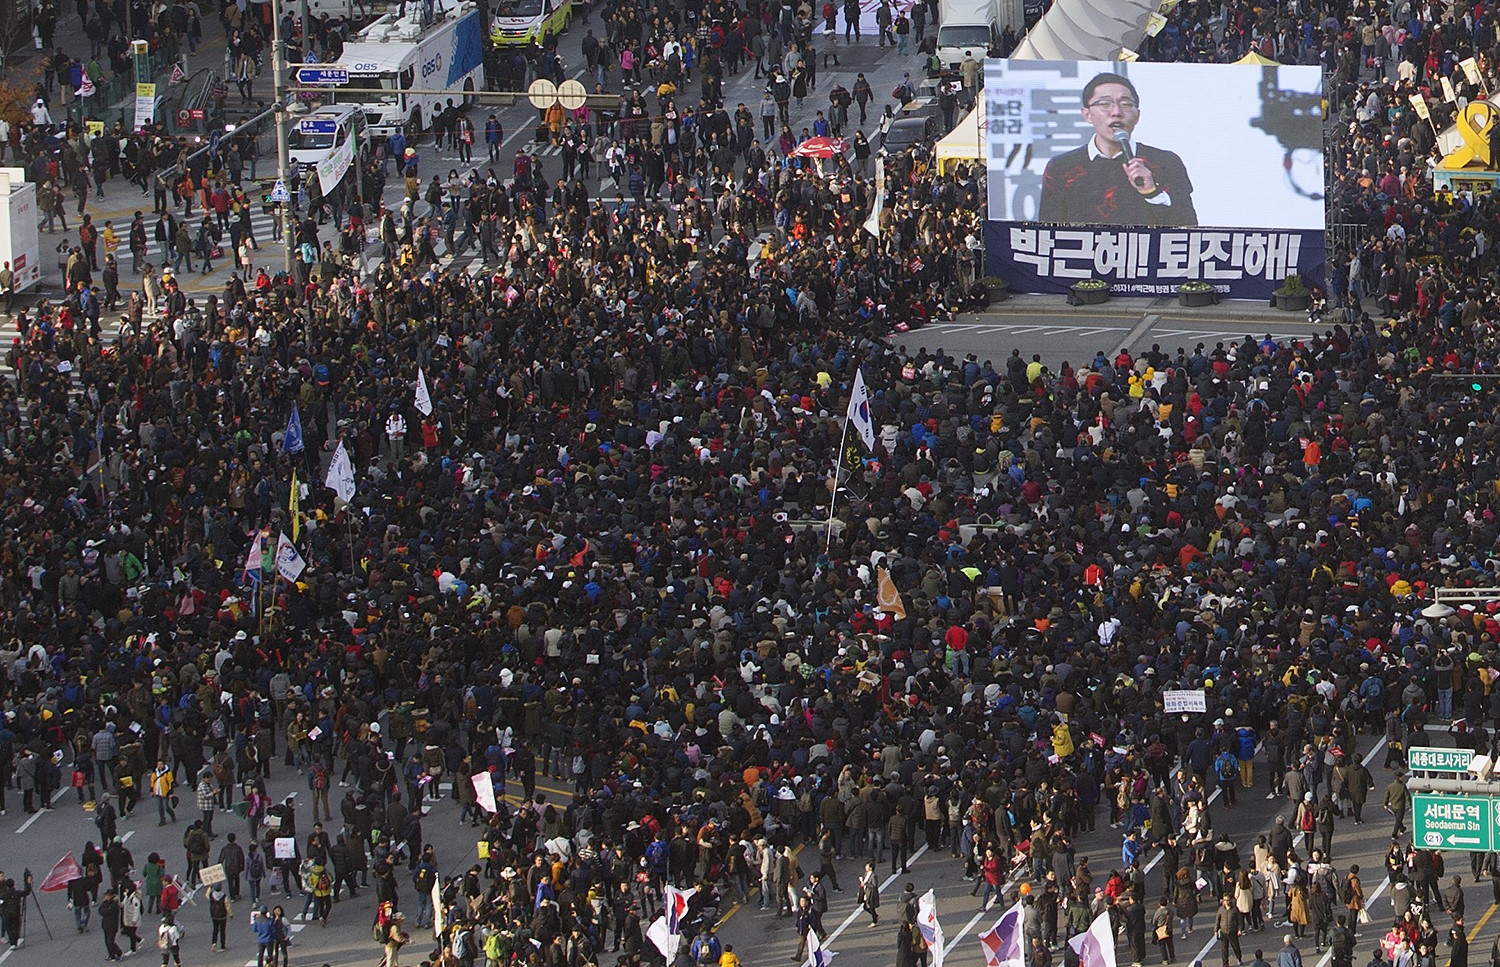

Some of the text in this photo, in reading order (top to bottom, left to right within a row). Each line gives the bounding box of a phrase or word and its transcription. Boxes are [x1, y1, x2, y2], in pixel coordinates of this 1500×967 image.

[354, 63, 378, 71] OBS
[422, 58, 435, 78] OBS
[1009, 227, 1302, 280] 박근혜! 퇴진해!
[1411, 753, 1470, 767] 세종대로사거리
[1424, 804, 1480, 820] 서대문역
[1425, 819, 1480, 831] Seodaemun Stn
[1427, 834, 1440, 843] 21
